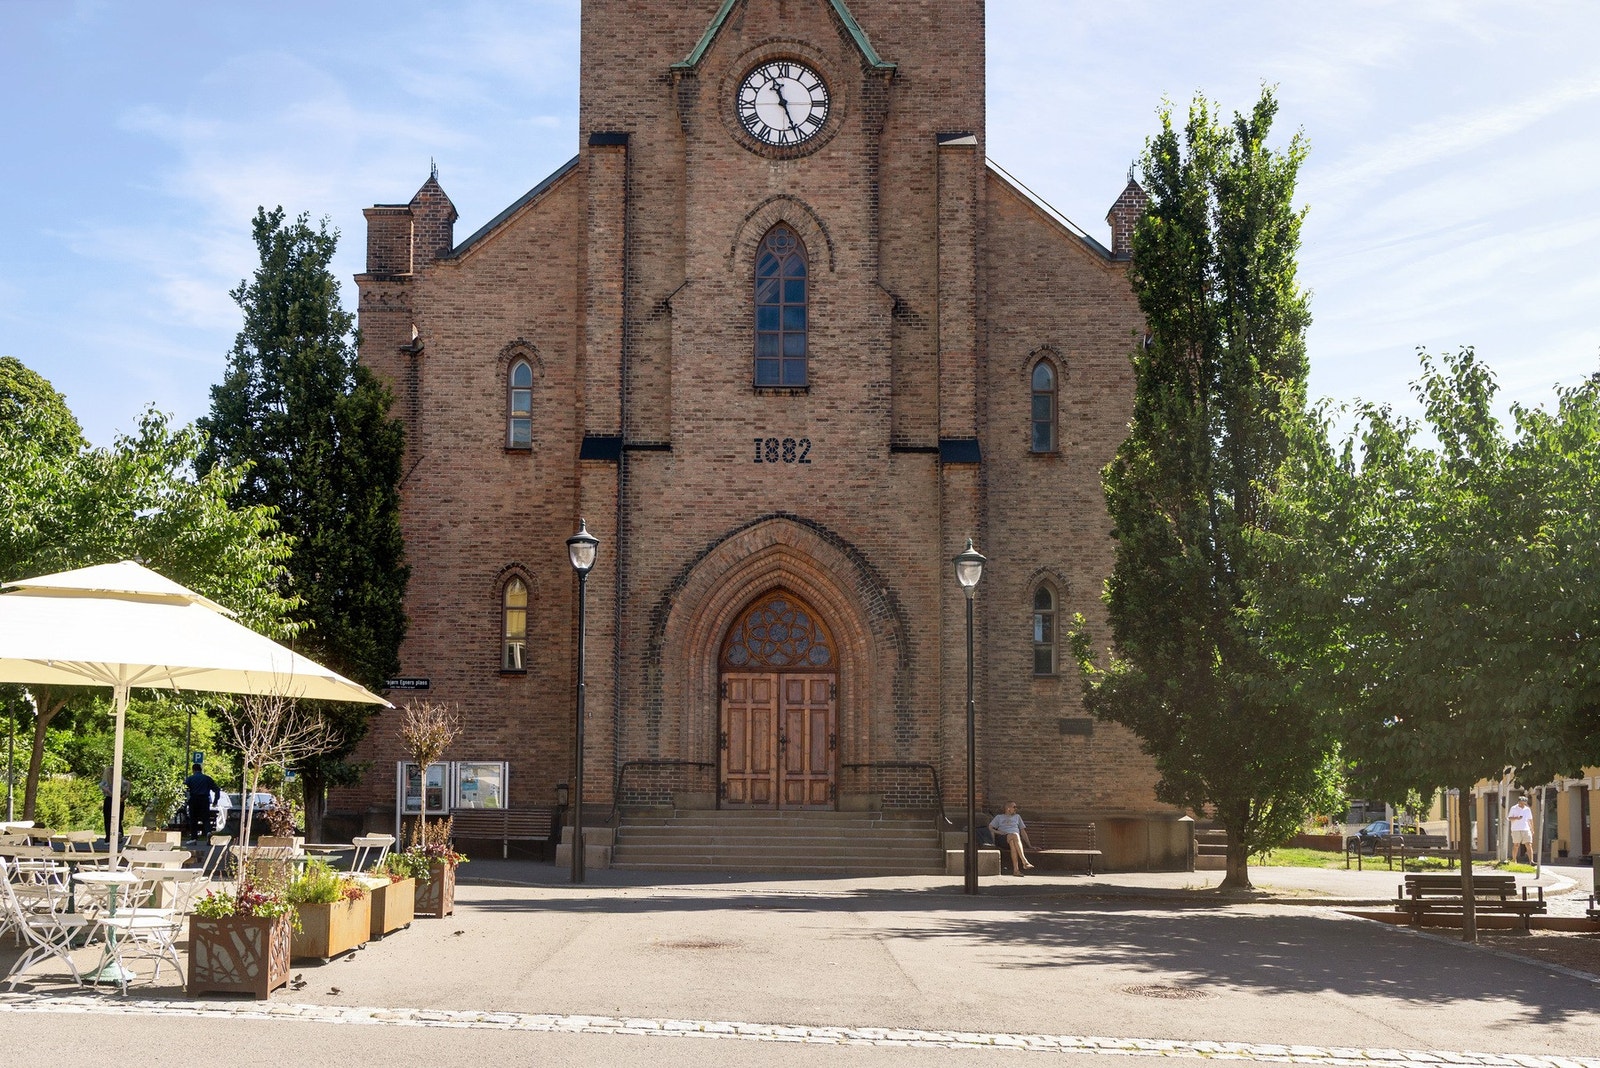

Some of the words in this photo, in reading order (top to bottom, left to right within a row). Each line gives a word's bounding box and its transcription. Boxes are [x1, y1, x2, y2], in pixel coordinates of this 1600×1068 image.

[777, 65, 789, 78] XII
[744, 81, 760, 93] X
[807, 82, 821, 92] II
[741, 100, 755, 109] IX
[744, 112, 760, 129] VIII
[758, 123, 772, 141] VII
[779, 130, 789, 143] VI
[754, 438, 811, 463] 1882
[196, 754, 201, 762] P
